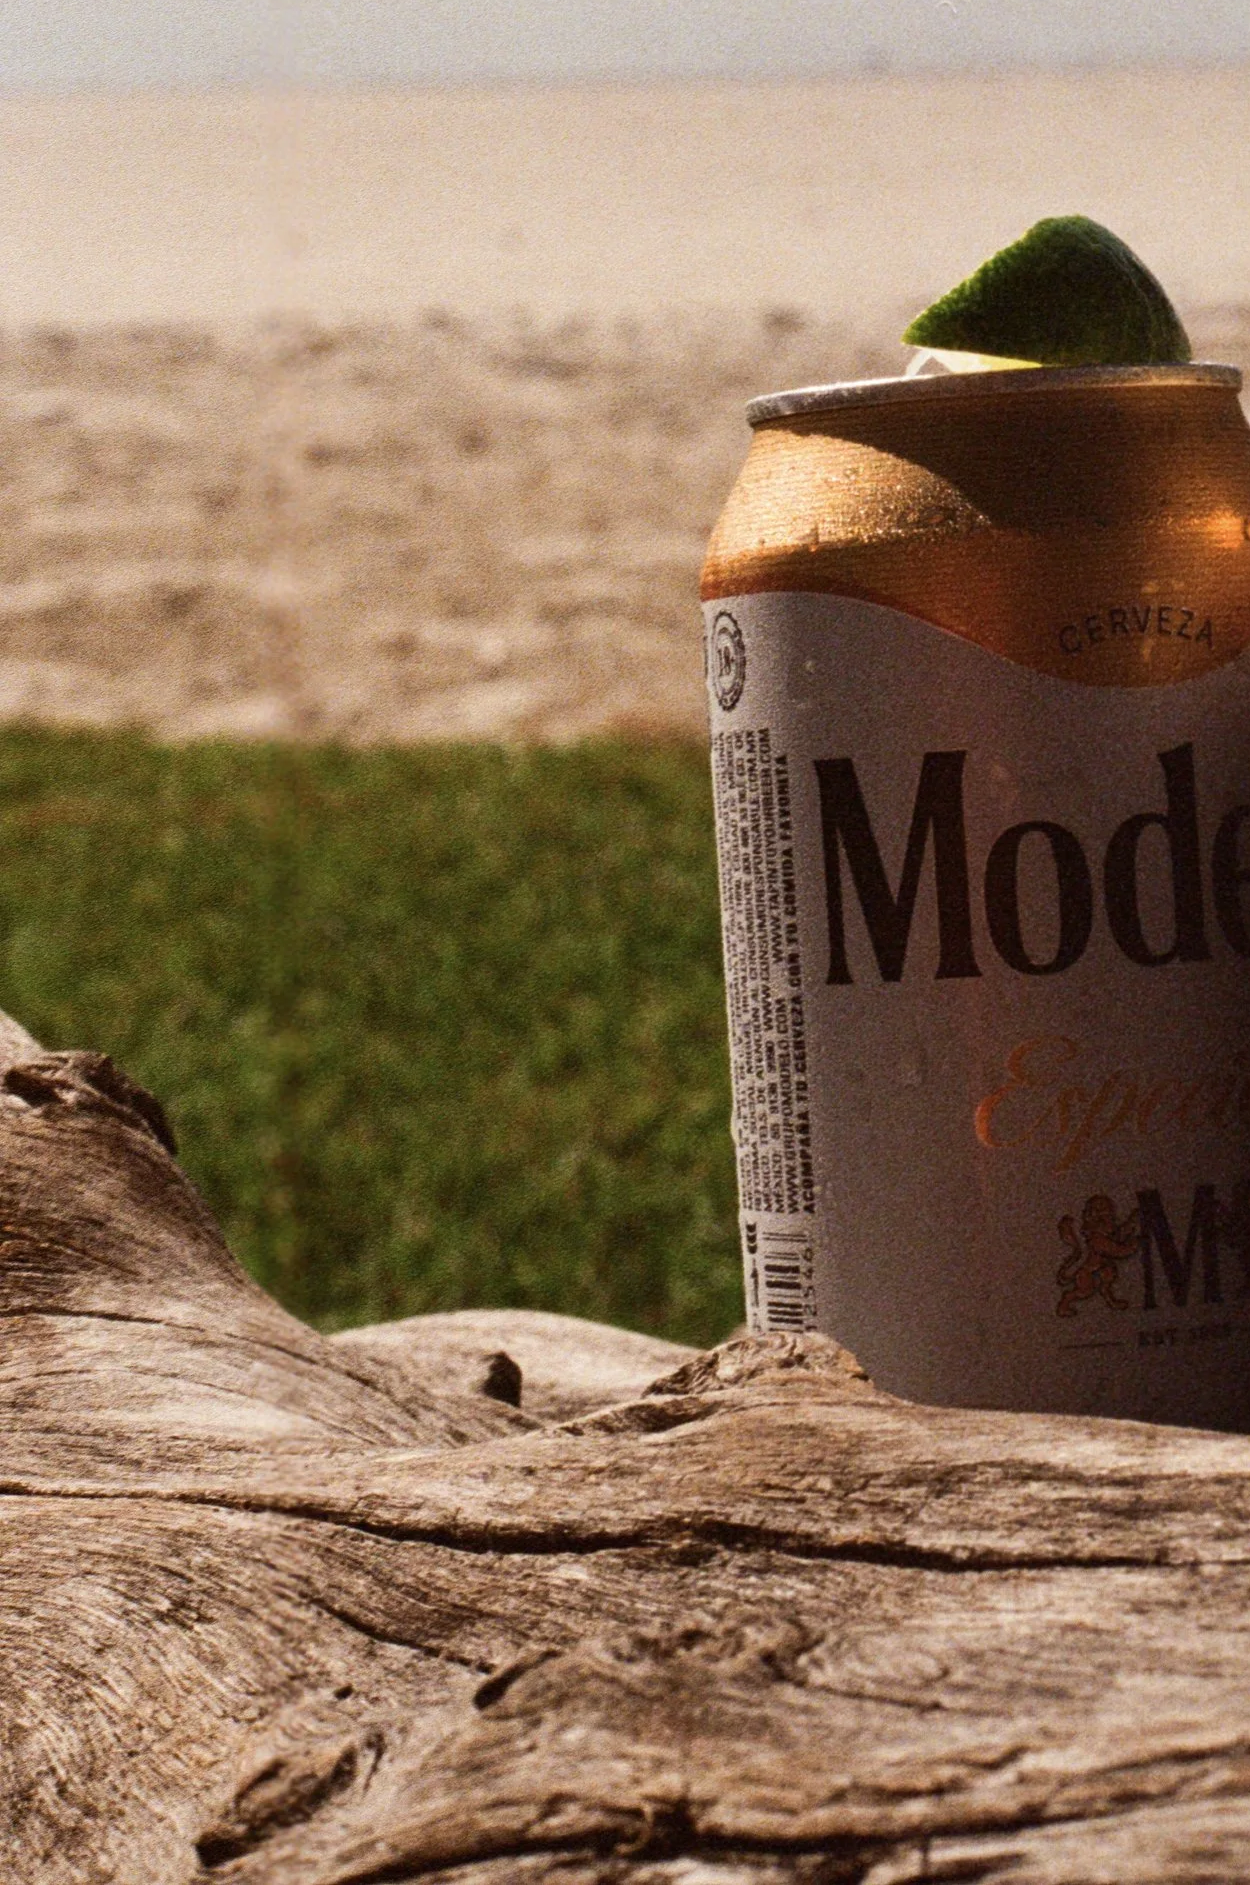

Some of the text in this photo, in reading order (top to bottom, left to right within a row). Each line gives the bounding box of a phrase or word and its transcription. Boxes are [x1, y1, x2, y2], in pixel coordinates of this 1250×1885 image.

[1058, 604, 1214, 653] CERVEZA
[758, 726, 799, 1214] WWW.GRUPOMODELO.COM WWW.TAPINTOYOURBEER.COM
[774, 754, 814, 1214] ACOMPAÑA TU CERVEZA CON TU COMIDA FAVORITA
